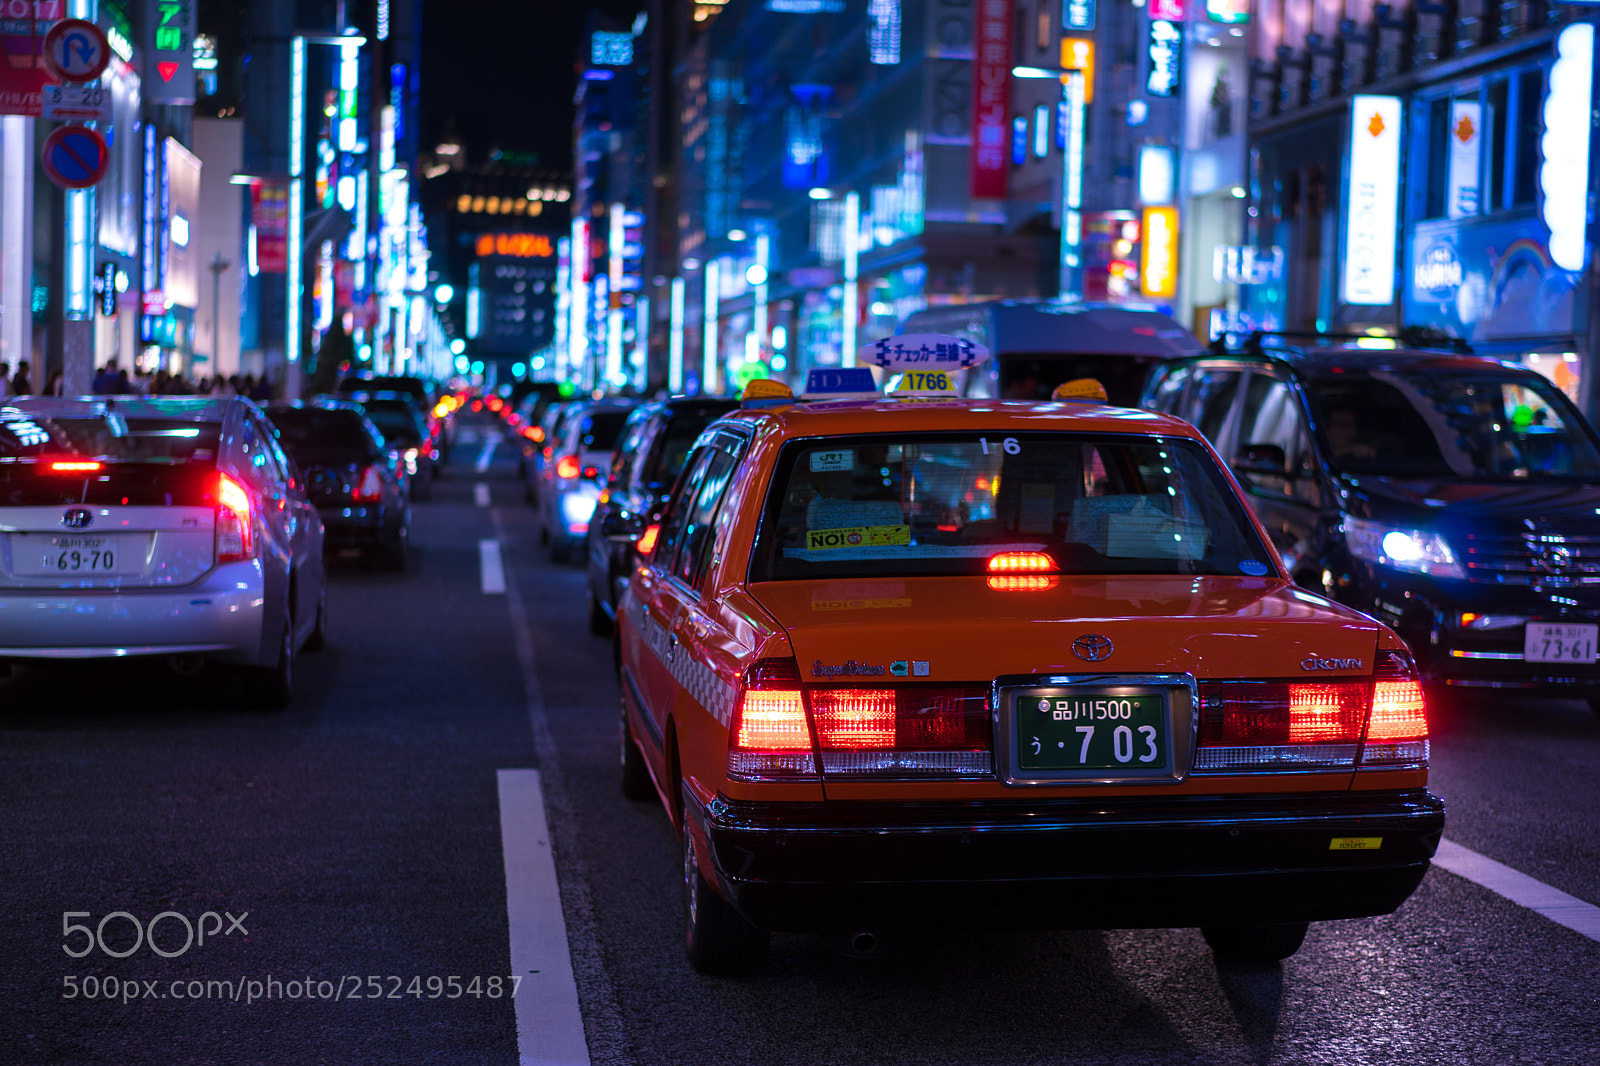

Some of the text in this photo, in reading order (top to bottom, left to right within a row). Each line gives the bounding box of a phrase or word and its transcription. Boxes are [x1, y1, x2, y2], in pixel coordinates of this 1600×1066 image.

[0, 0, 60, 19] 017
[894, 344, 960, 362] チェッカー無線
[907, 373, 948, 390] 1766
[811, 534, 845, 547] NO!
[58, 551, 113, 570] 69-70
[1542, 639, 1590, 659] 73-61
[1301, 658, 1362, 671] CROWN
